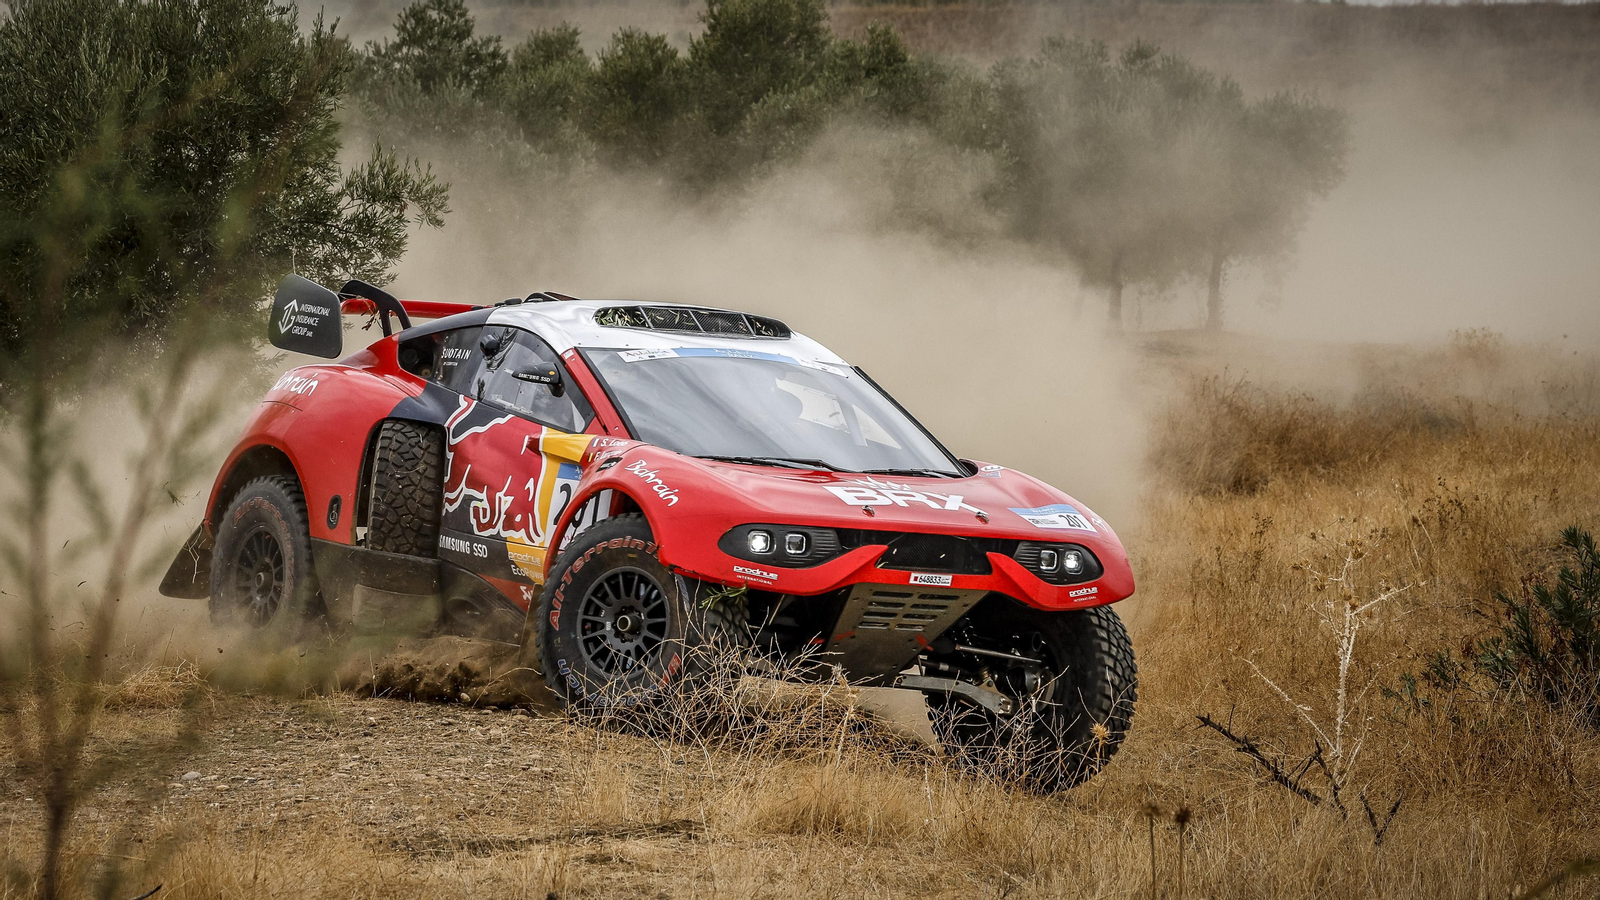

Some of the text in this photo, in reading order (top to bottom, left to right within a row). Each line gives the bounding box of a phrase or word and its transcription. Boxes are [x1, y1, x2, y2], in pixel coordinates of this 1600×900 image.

[299, 303, 331, 317] INTERNATIONAL
[295, 315, 320, 327] INSURANCE
[291, 325, 308, 336] GROUP
[624, 459, 679, 507] Bahrain
[821, 485, 990, 516] BRX
[1058, 514, 1088, 530] 201
[439, 534, 488, 559] SAMSUNG SSD
[511, 564, 545, 581] EcoPowe
[736, 574, 774, 585] INTERNATIONAL
[918, 575, 942, 585] 648833
